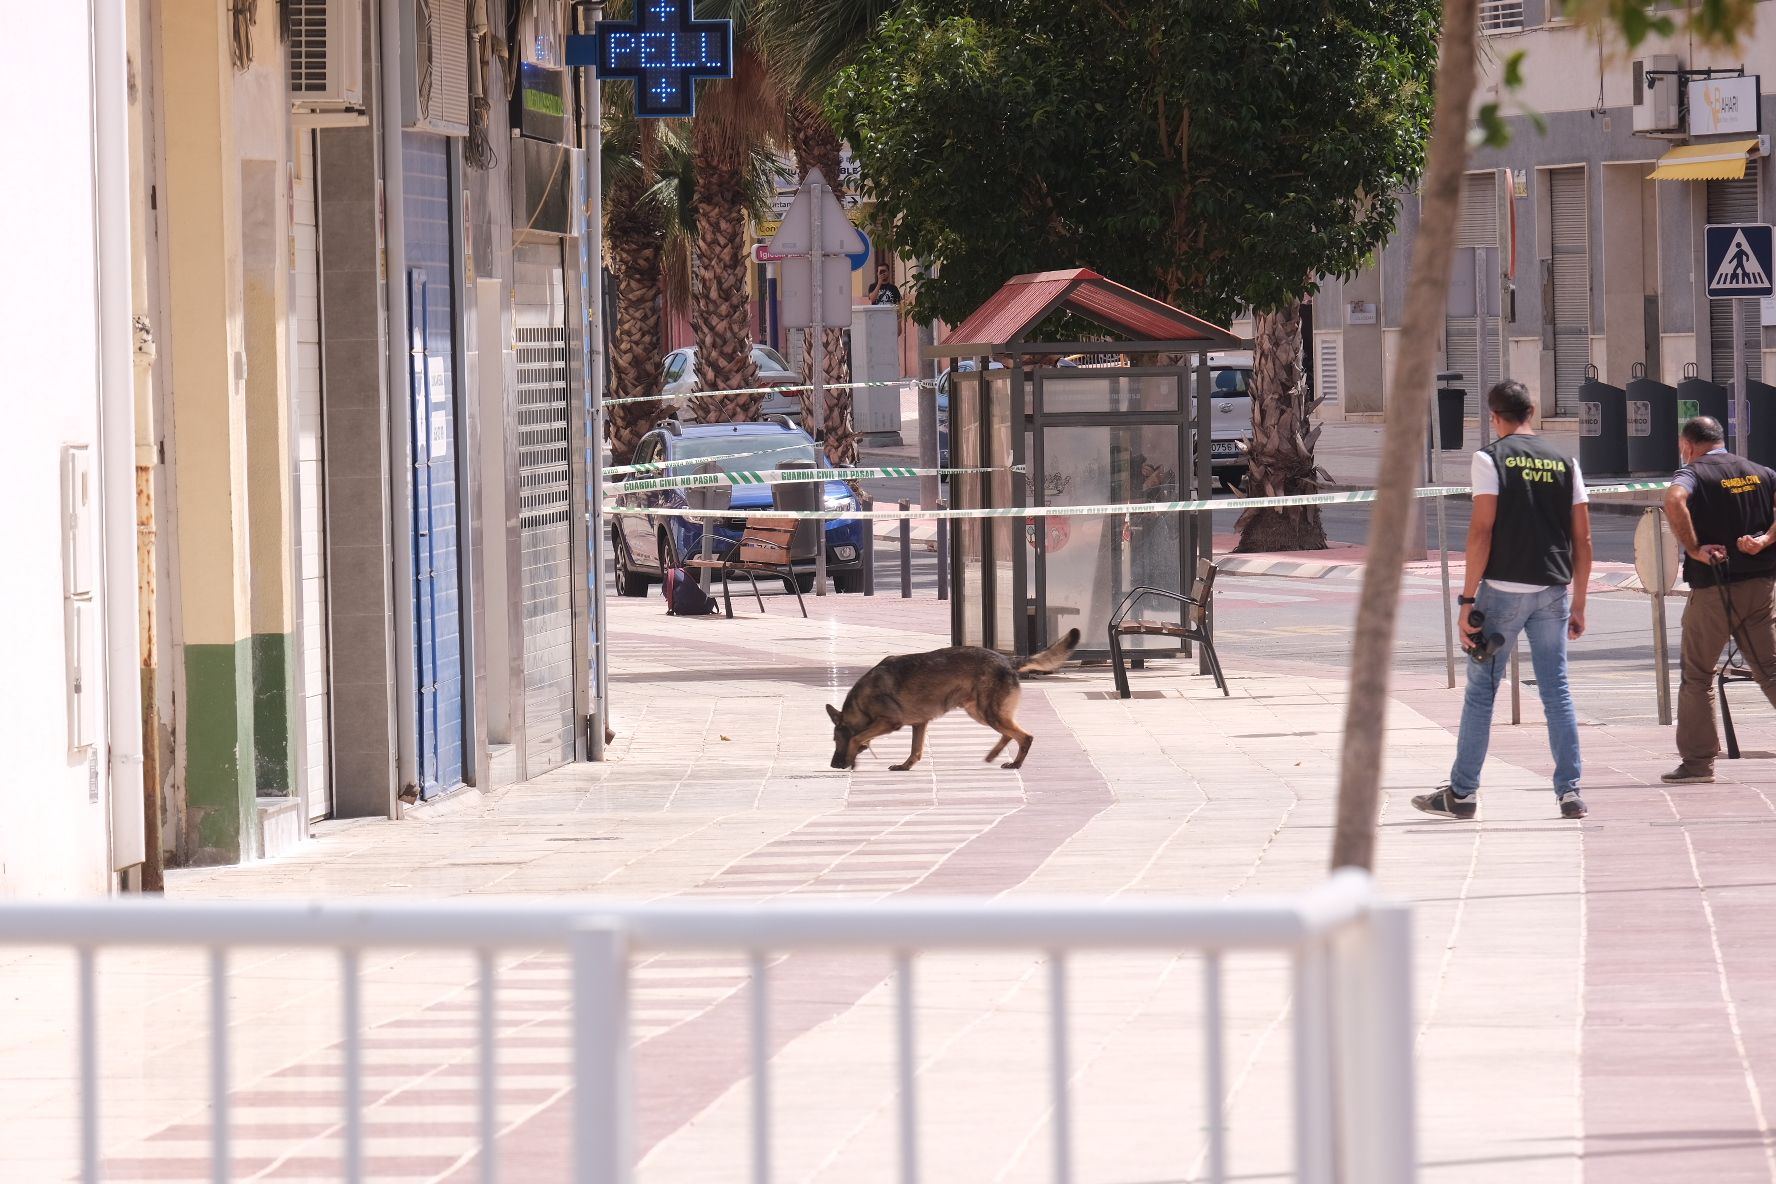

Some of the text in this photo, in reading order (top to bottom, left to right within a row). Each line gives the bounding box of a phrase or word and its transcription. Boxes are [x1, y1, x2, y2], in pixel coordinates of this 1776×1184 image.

[1505, 456, 1566, 472] GUARDIA
[780, 470, 875, 480] GUARDIA CIVIL NO PASAR
[1521, 469, 1554, 483] CIVIL
[623, 475, 719, 492] GUARDIA CIVIL NO PASAR
